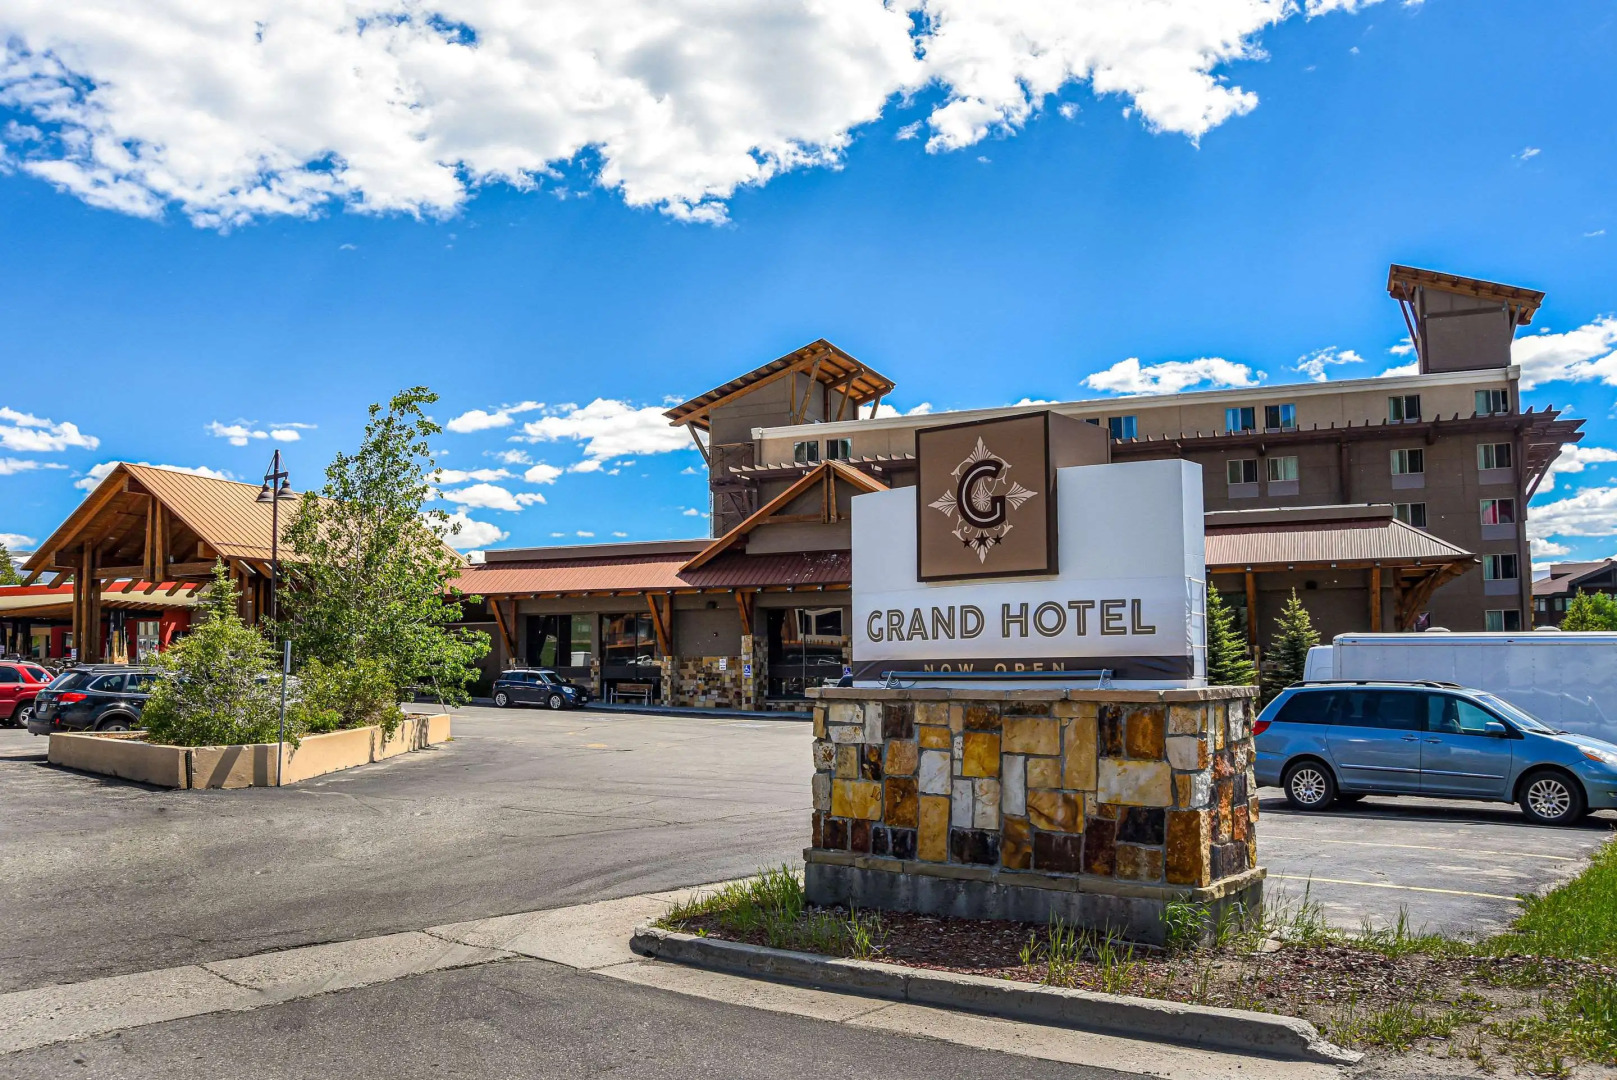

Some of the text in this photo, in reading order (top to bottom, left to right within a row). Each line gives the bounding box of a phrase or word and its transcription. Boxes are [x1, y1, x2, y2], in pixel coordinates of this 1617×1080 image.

[957, 459, 1006, 529] G
[866, 598, 1157, 643] GRAND HOTEL
[923, 662, 1065, 672] NOW OPEN
